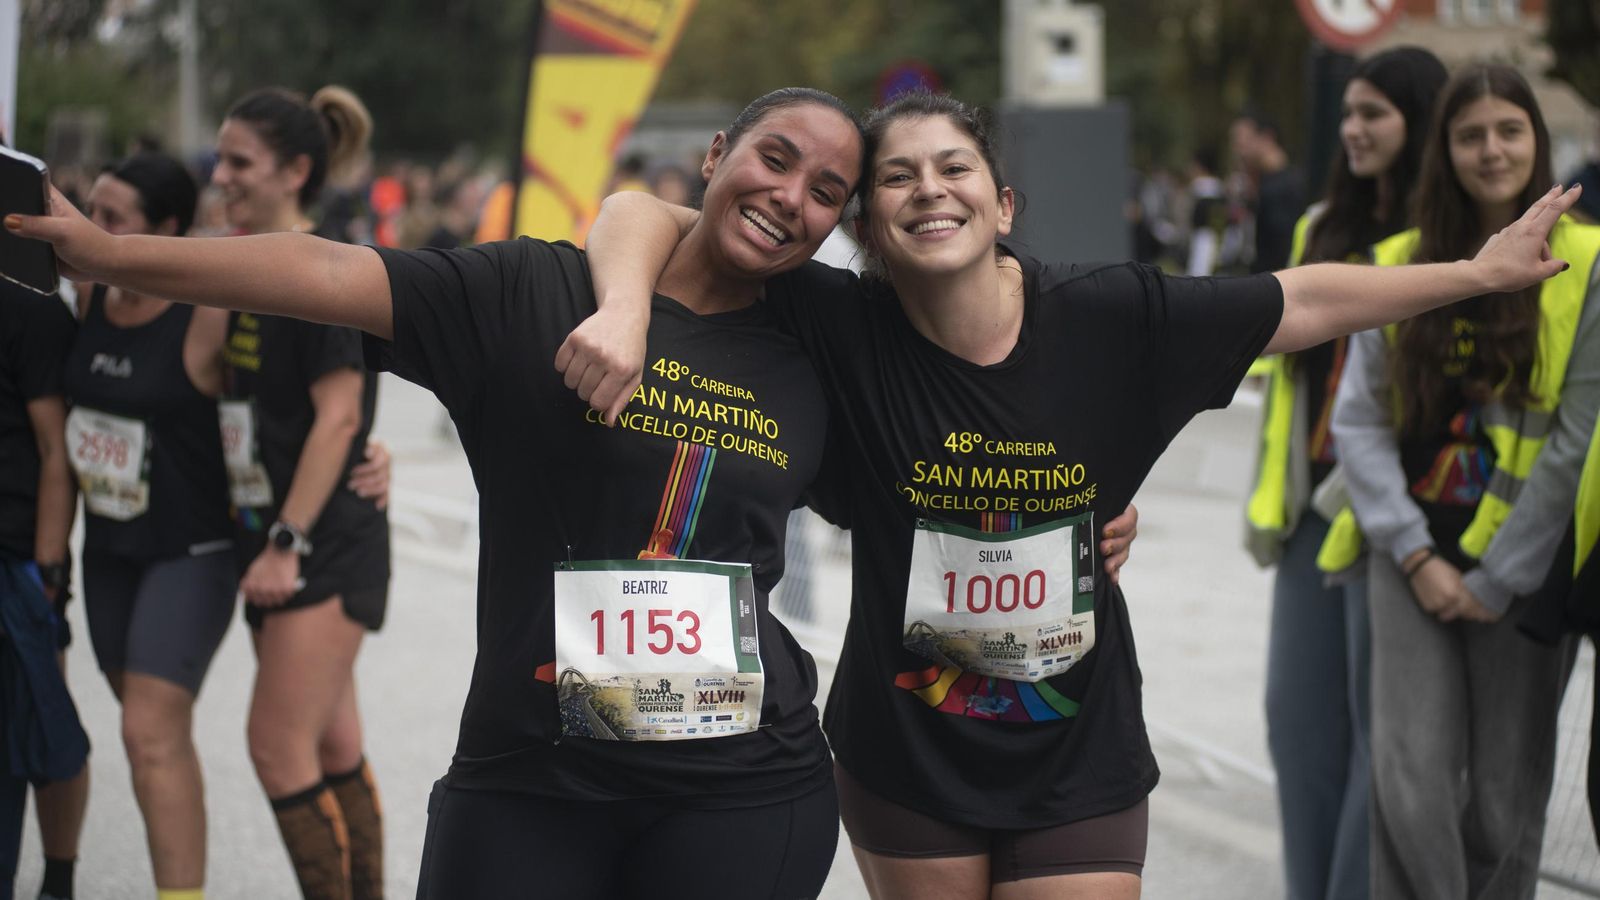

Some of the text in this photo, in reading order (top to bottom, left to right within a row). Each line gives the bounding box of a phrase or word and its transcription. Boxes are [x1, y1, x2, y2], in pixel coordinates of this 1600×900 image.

[691, 374, 755, 402] CARREIRA
[629, 384, 779, 440] AN MARTIÑO
[691, 426, 717, 446] DE
[720, 433, 789, 471] OURENSE
[985, 441, 1057, 456] CARREIRA
[912, 461, 1085, 491] SAN MARTIÑO
[896, 481, 1097, 512] CONCELLO DE OURENSE
[978, 549, 1013, 563] SILVIA
[622, 580, 668, 595] BEATRIZ
[943, 569, 1046, 614] 1000
[590, 609, 702, 655] 1153
[1040, 631, 1082, 651] XLVIII
[638, 688, 659, 696] SAN
[698, 690, 745, 705] XLVIII
